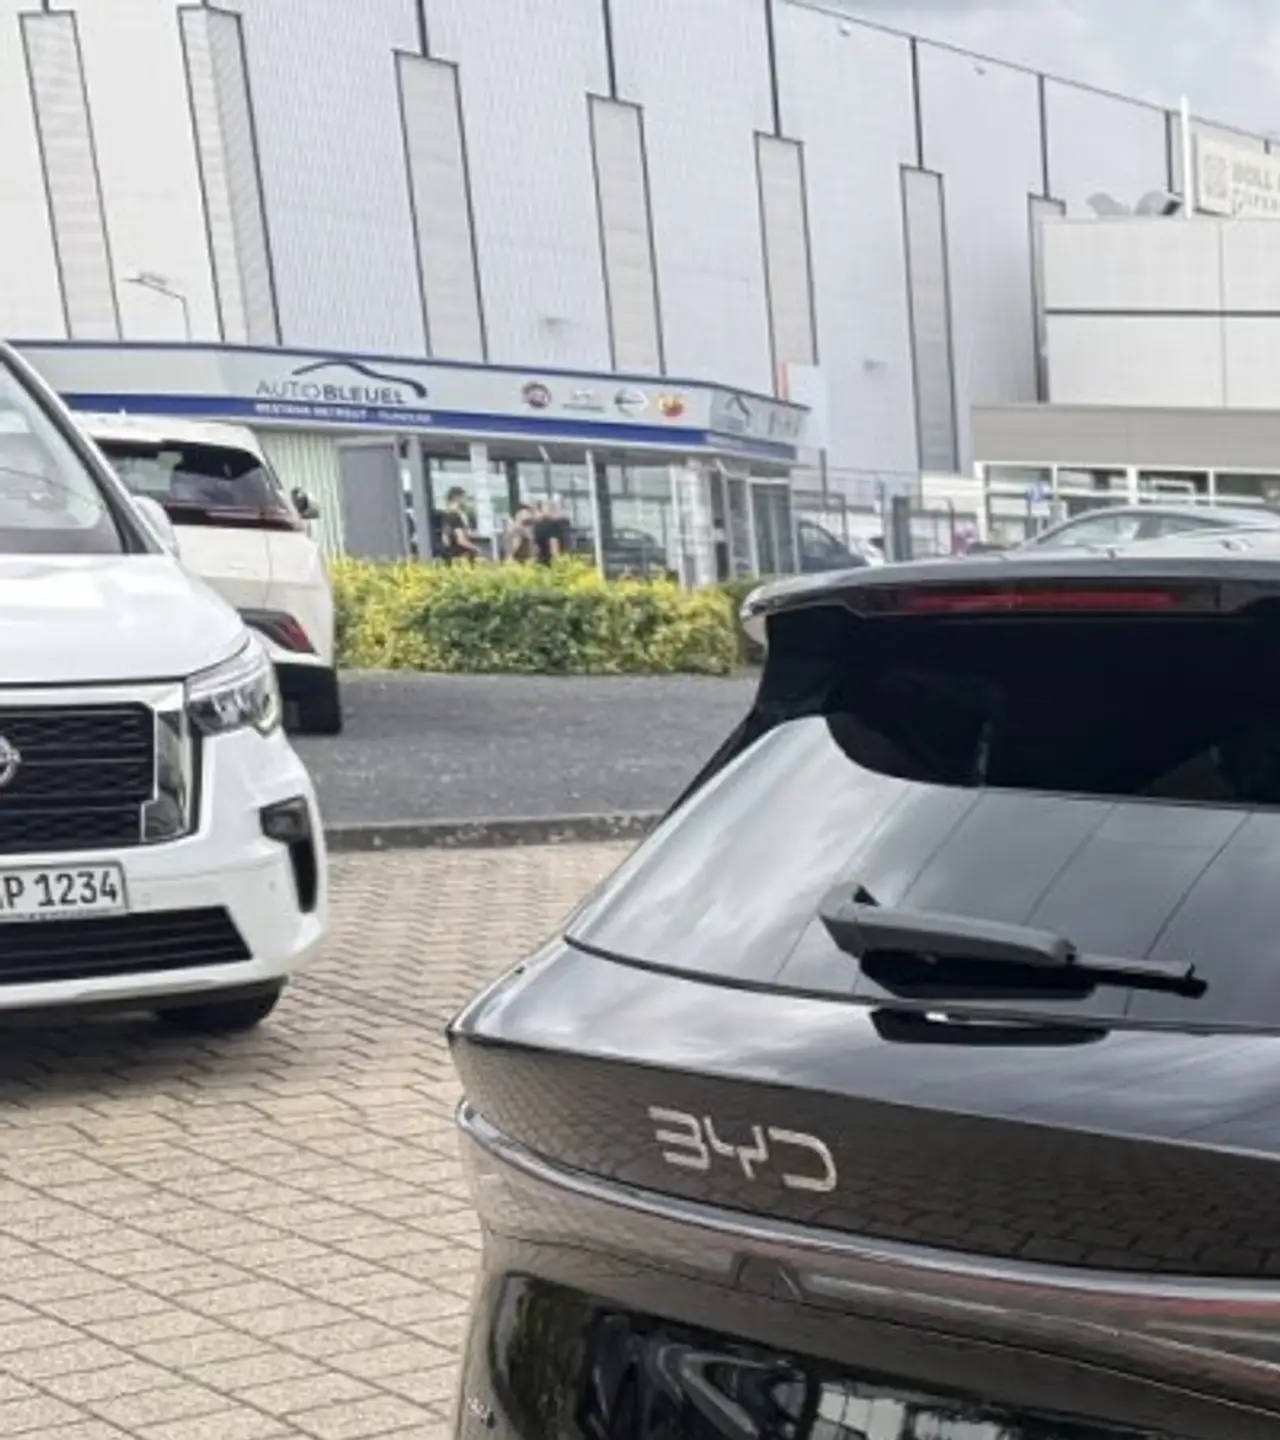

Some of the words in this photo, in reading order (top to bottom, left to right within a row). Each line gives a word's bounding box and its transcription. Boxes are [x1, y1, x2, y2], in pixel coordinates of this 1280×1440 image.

[0, 873, 25, 909] P
[33, 870, 118, 908] 1234
[648, 1106, 838, 1192] BYD
